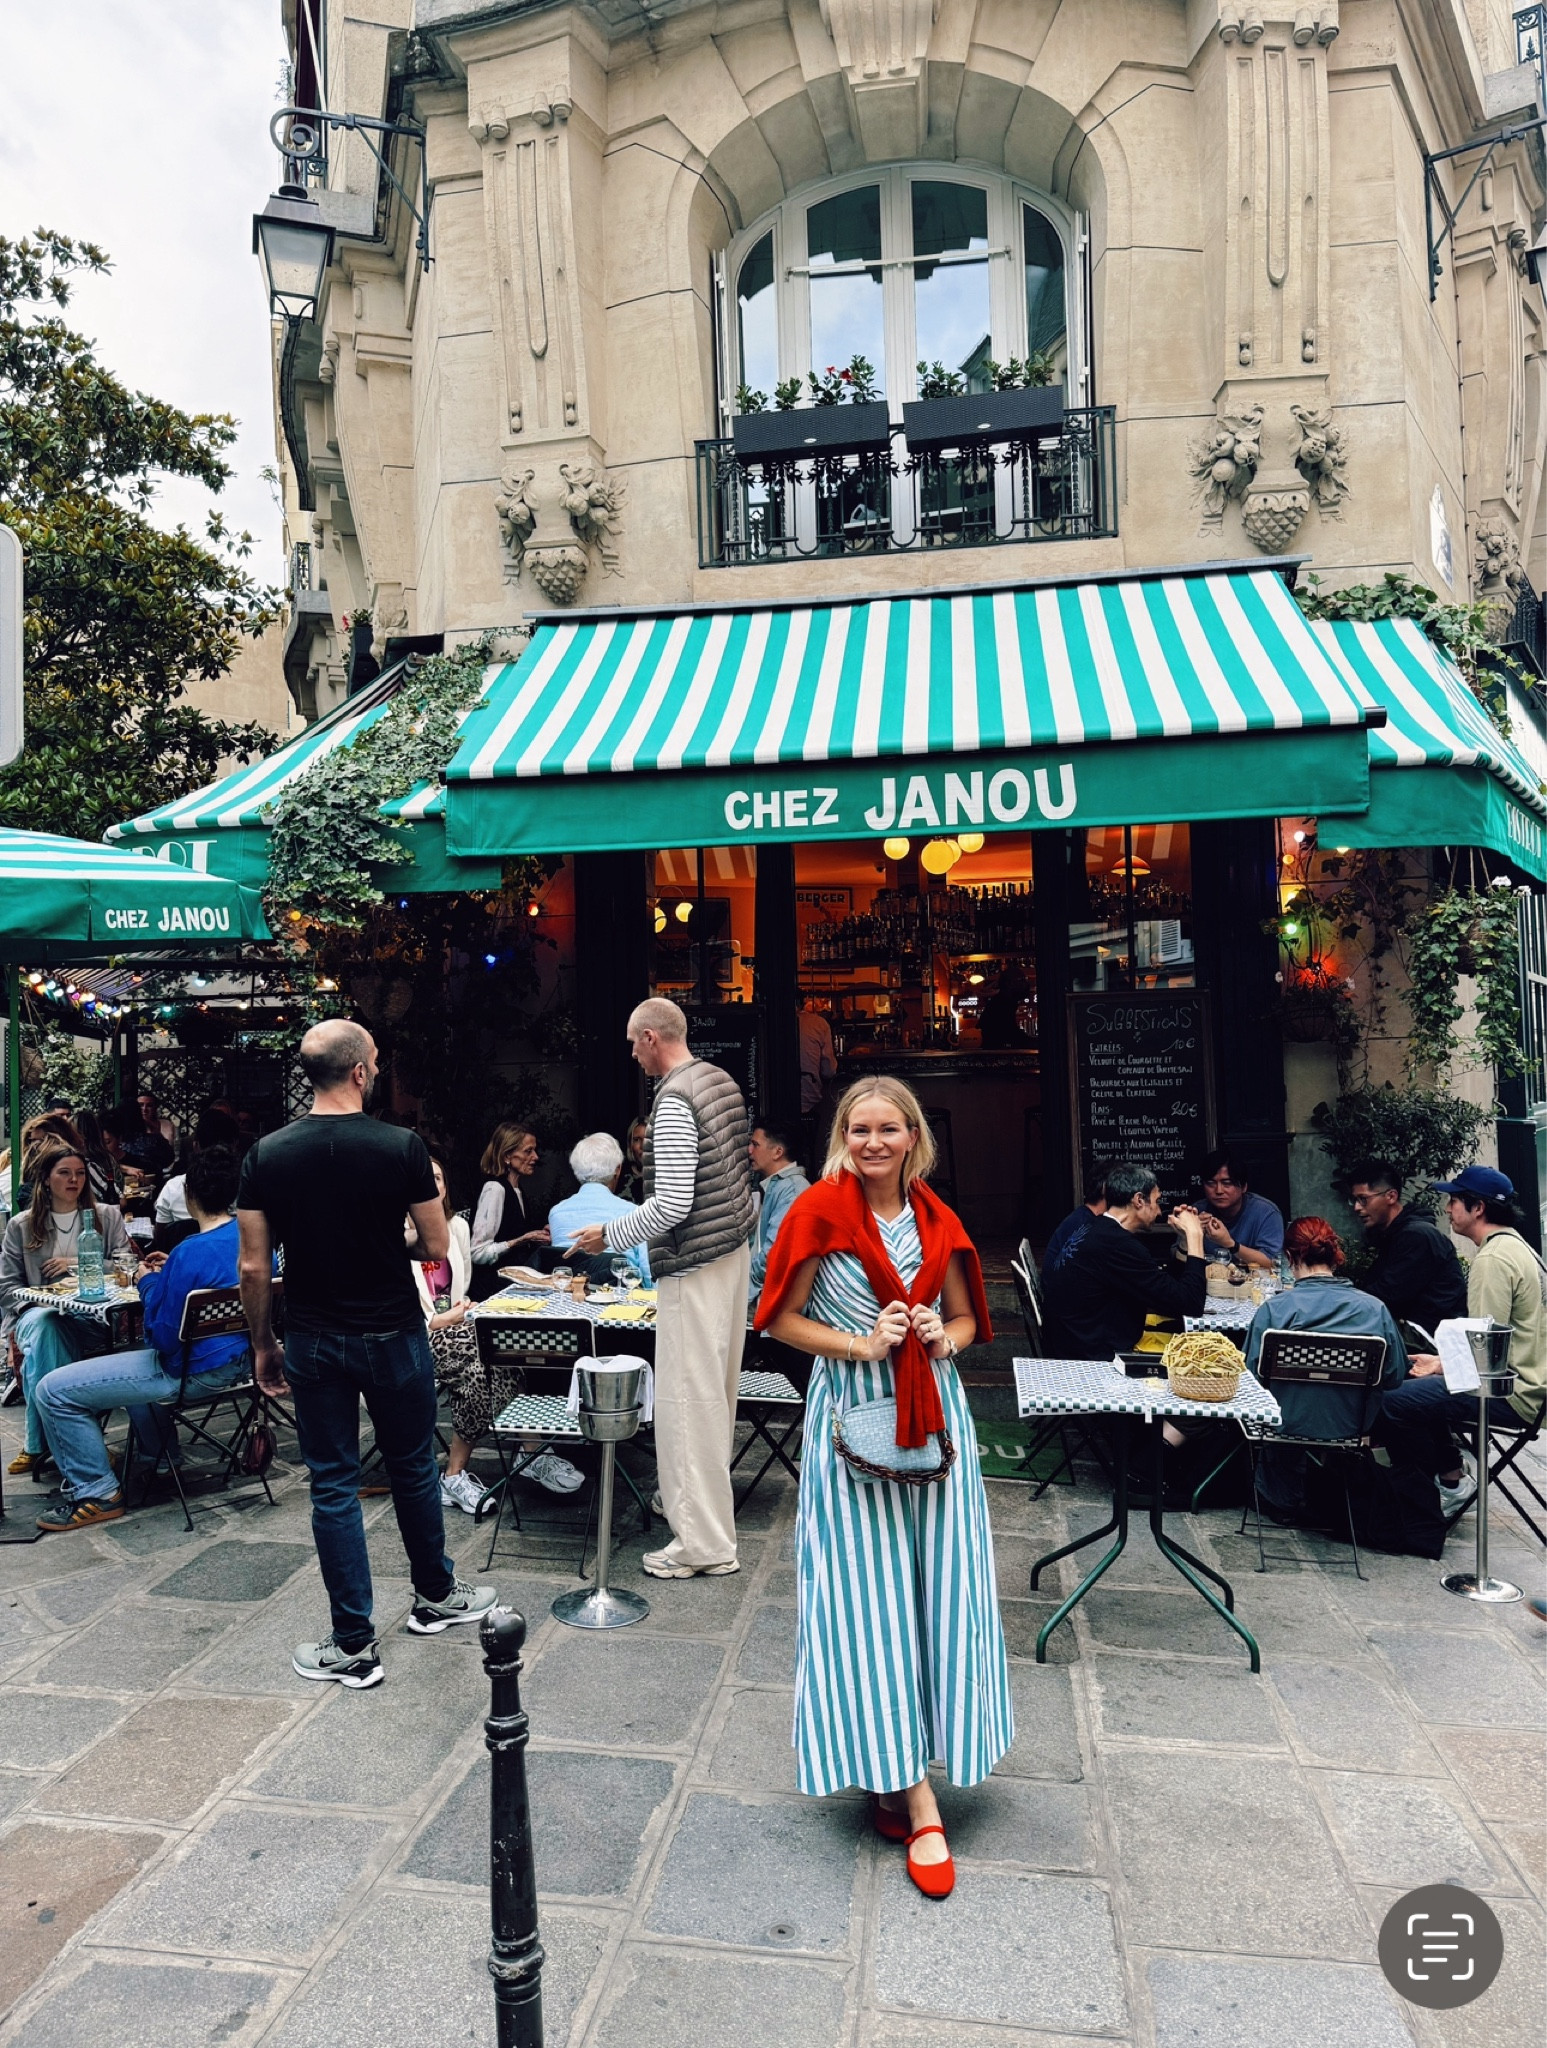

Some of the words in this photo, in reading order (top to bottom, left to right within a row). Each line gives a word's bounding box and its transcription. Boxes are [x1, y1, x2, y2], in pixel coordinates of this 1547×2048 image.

[724, 787, 839, 830] CHEZ
[864, 763, 1078, 830] JANOU
[797, 893, 845, 903] BERGER
[105, 909, 149, 929] CHEZ
[158, 907, 230, 932] JANOU
